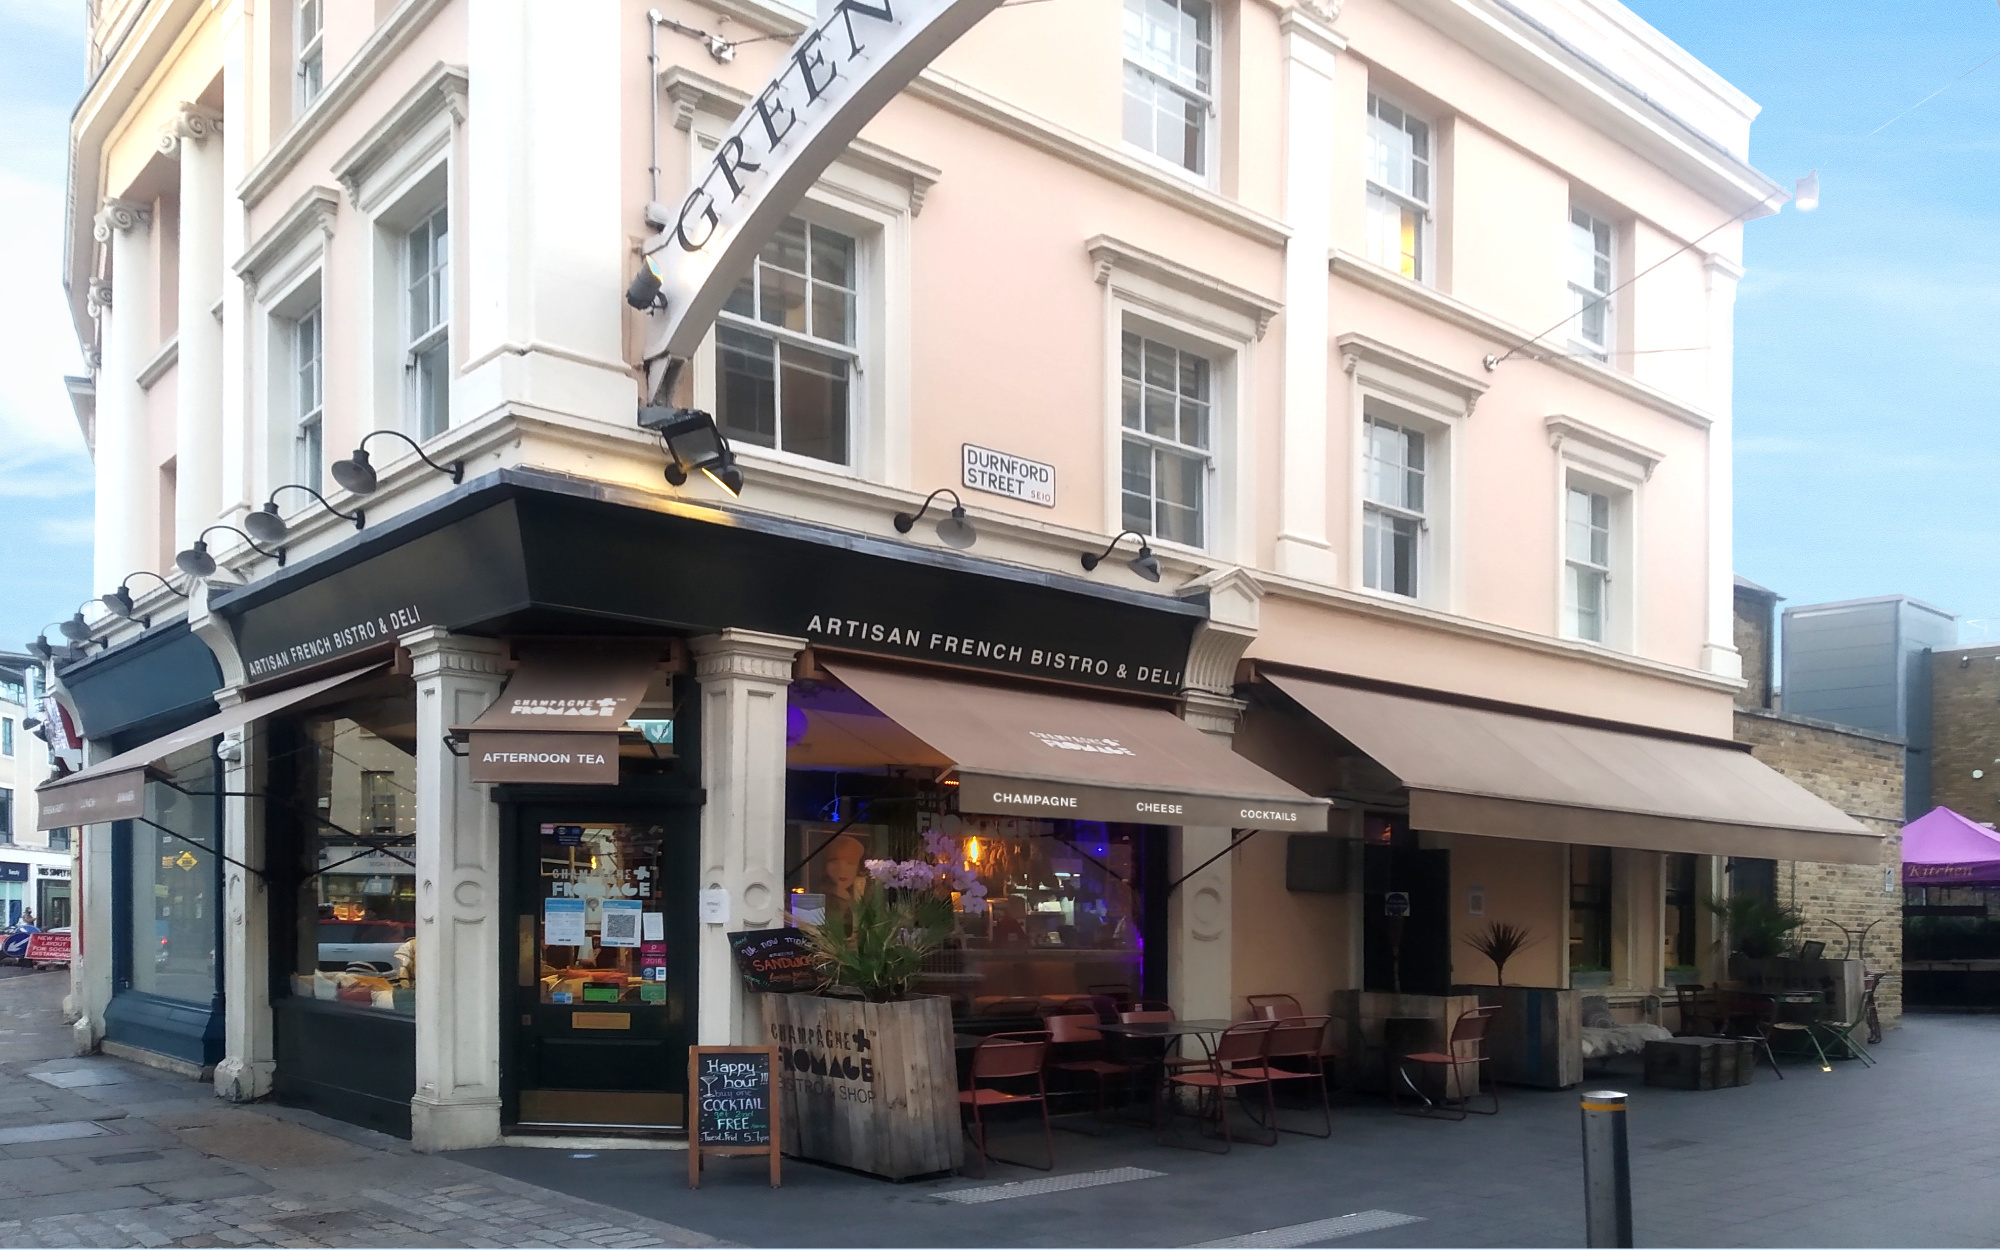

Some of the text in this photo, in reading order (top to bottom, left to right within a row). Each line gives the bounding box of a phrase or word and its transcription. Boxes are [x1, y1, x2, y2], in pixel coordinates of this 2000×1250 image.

[967, 449, 1049, 483] DURNFORD
[967, 467, 1025, 495] STREET
[1030, 489, 1051, 502] SE10
[249, 604, 421, 676] ARTISAN FRENCH BISTRO & DELI
[806, 614, 1181, 687] ARTISAN FRENCH BISTRO & DELI
[514, 699, 594, 707] CHAMPAGNE
[511, 706, 615, 717] FROMAGE
[482, 753, 605, 764] AFTERNOON TEA
[993, 792, 1078, 808] CHAMPAGNE
[1136, 802, 1183, 814] CHEESE
[1240, 809, 1297, 822] COCKTAILS
[1909, 864, 1973, 879] Kitchen
[760, 938, 779, 949] now
[771, 1022, 851, 1051] CHAMPAGNE
[706, 1059, 756, 1077] Happy
[723, 1075, 758, 1088] hour
[838, 1085, 876, 1105] SHOP
[703, 1097, 766, 1112] COCKTAIL
[717, 1117, 749, 1130] FREE
